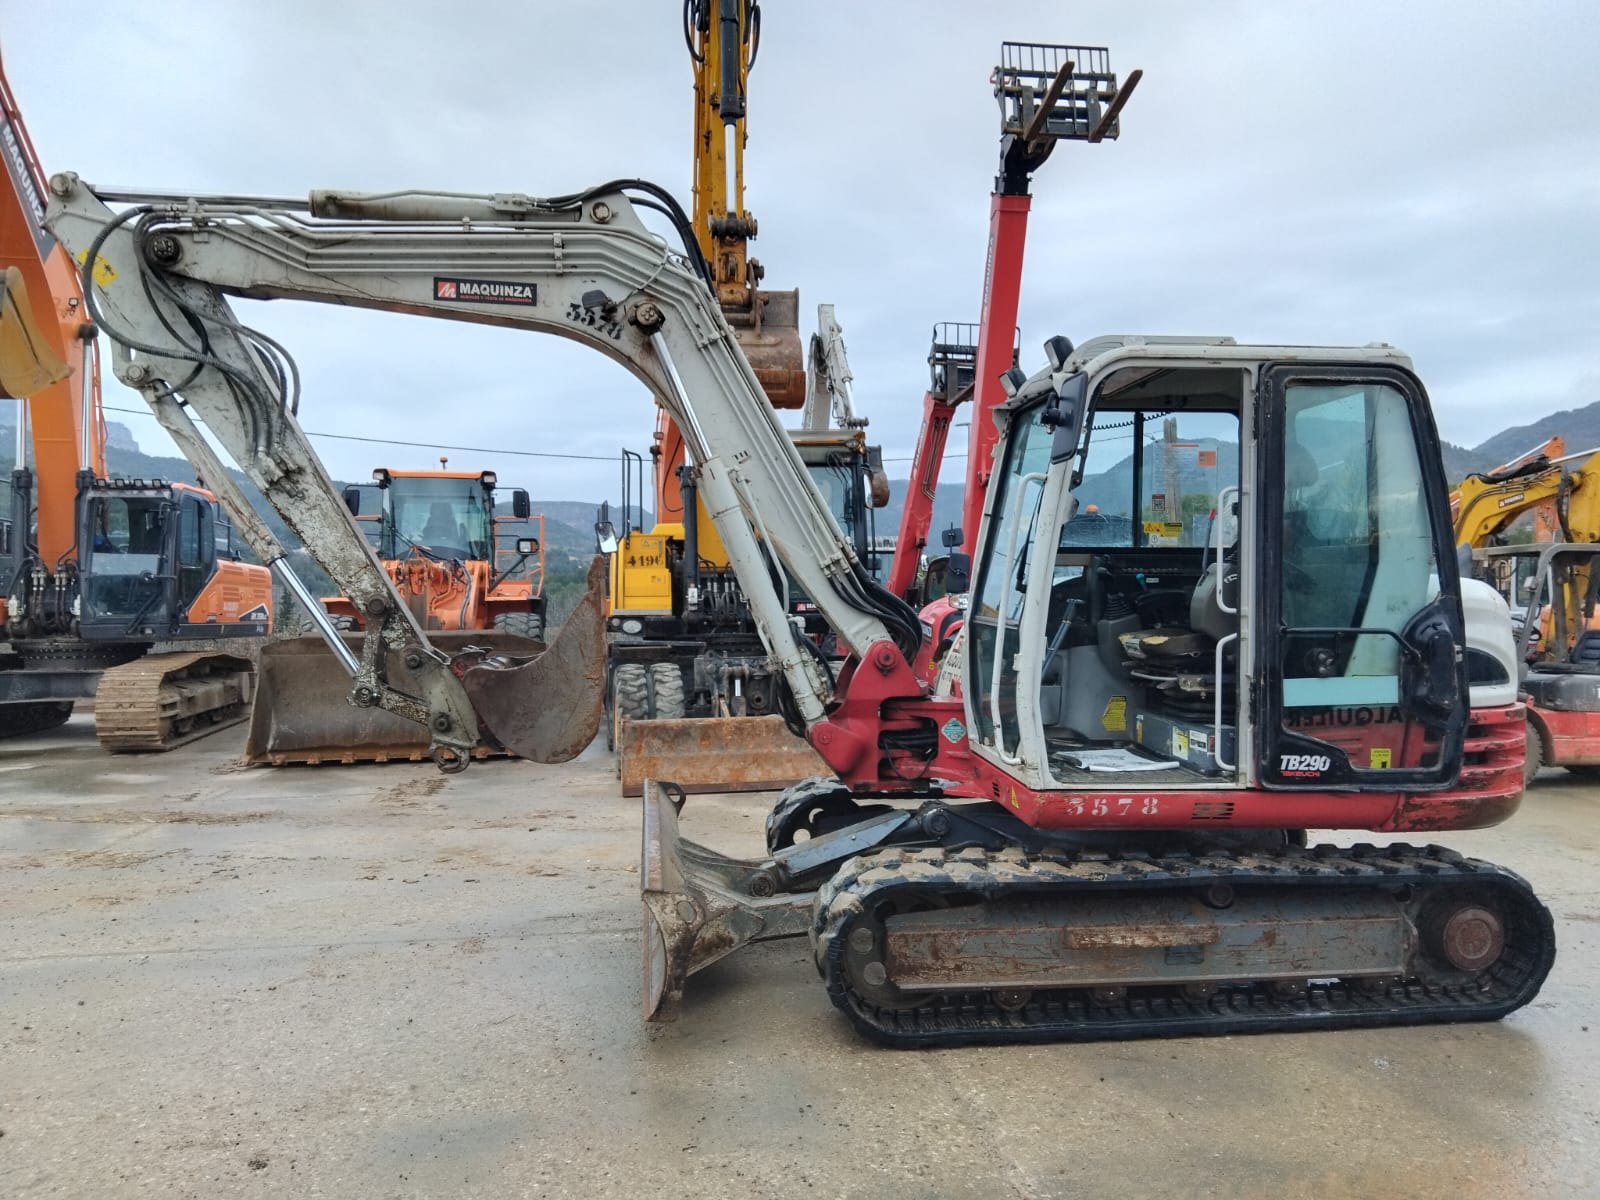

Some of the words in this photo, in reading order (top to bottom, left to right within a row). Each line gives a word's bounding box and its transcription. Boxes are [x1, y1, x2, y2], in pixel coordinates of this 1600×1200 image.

[3, 124, 46, 237] MAQUINZ
[459, 283, 532, 298] MAQUINZA
[1280, 755, 1331, 771] TB290
[1065, 797, 1158, 816] 3578
